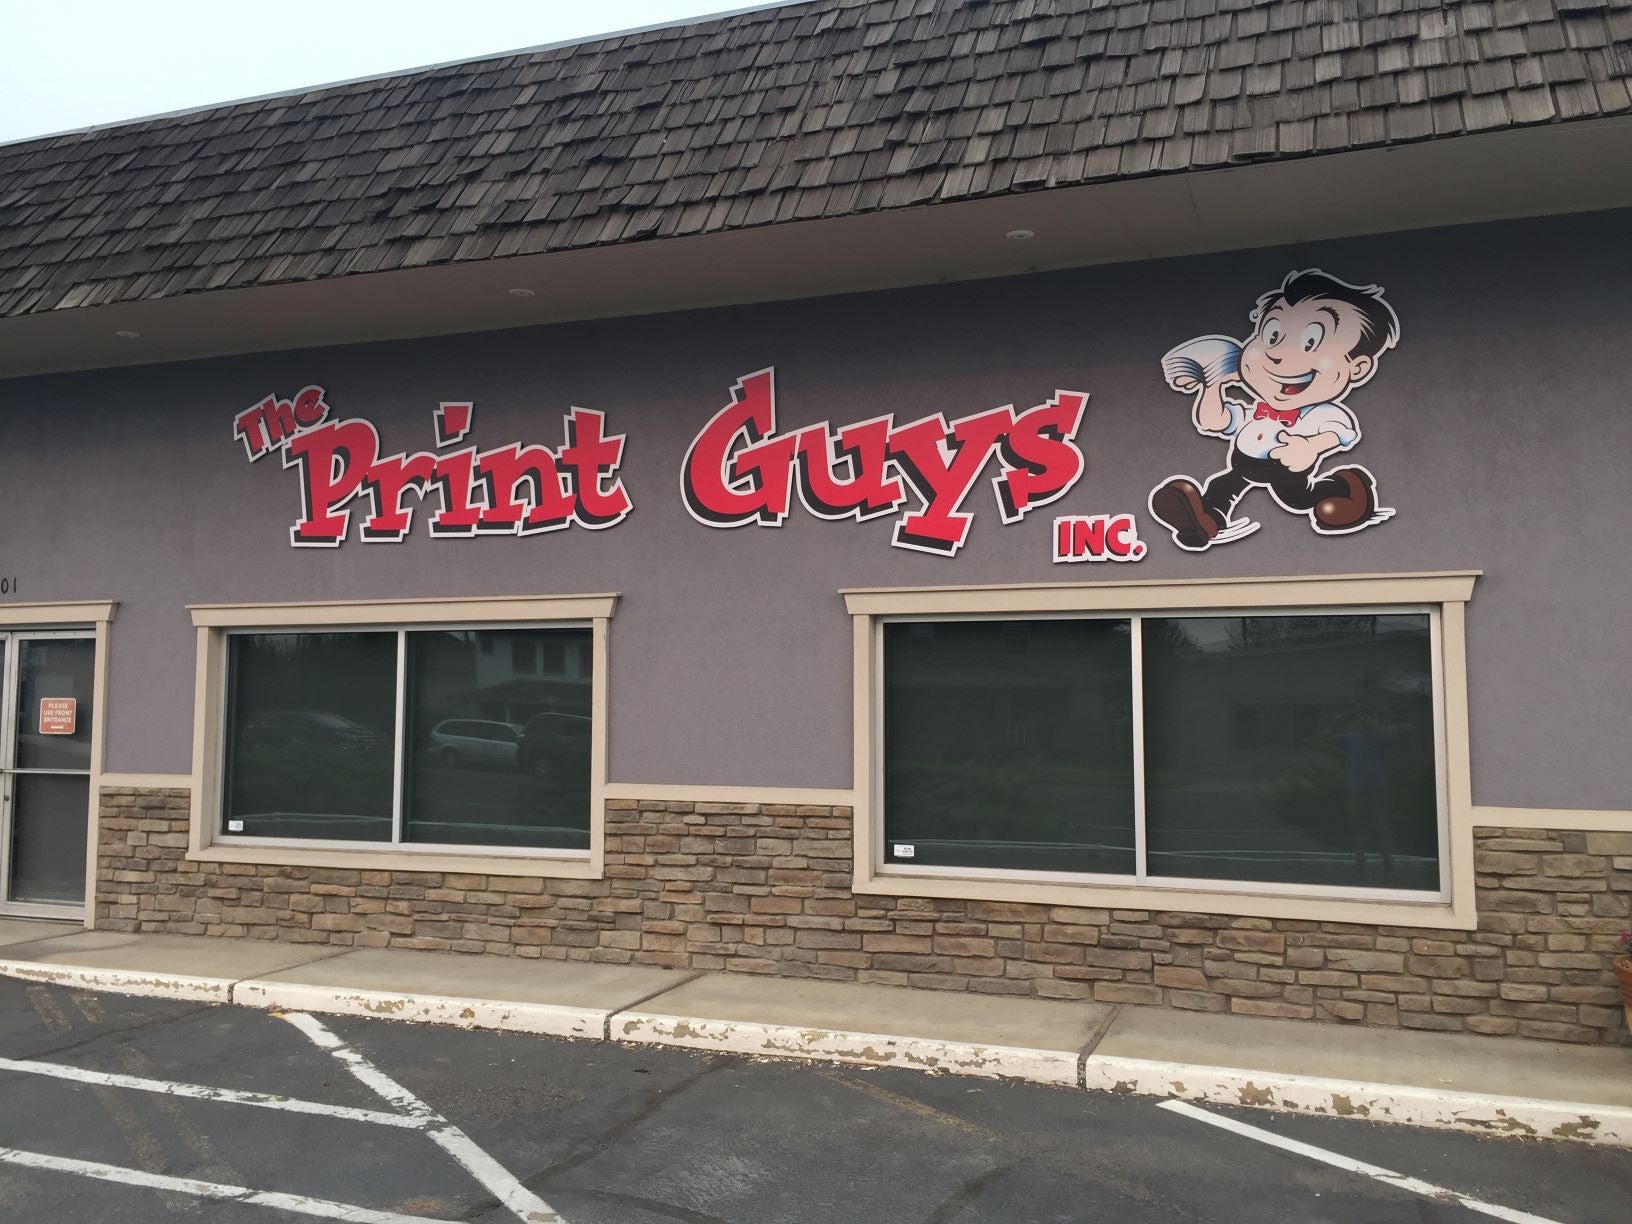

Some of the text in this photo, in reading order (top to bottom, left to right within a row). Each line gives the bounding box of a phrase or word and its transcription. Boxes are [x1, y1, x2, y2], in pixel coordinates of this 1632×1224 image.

[235, 367, 1089, 556] The Print Guys
[1054, 516, 1147, 562] INC.
